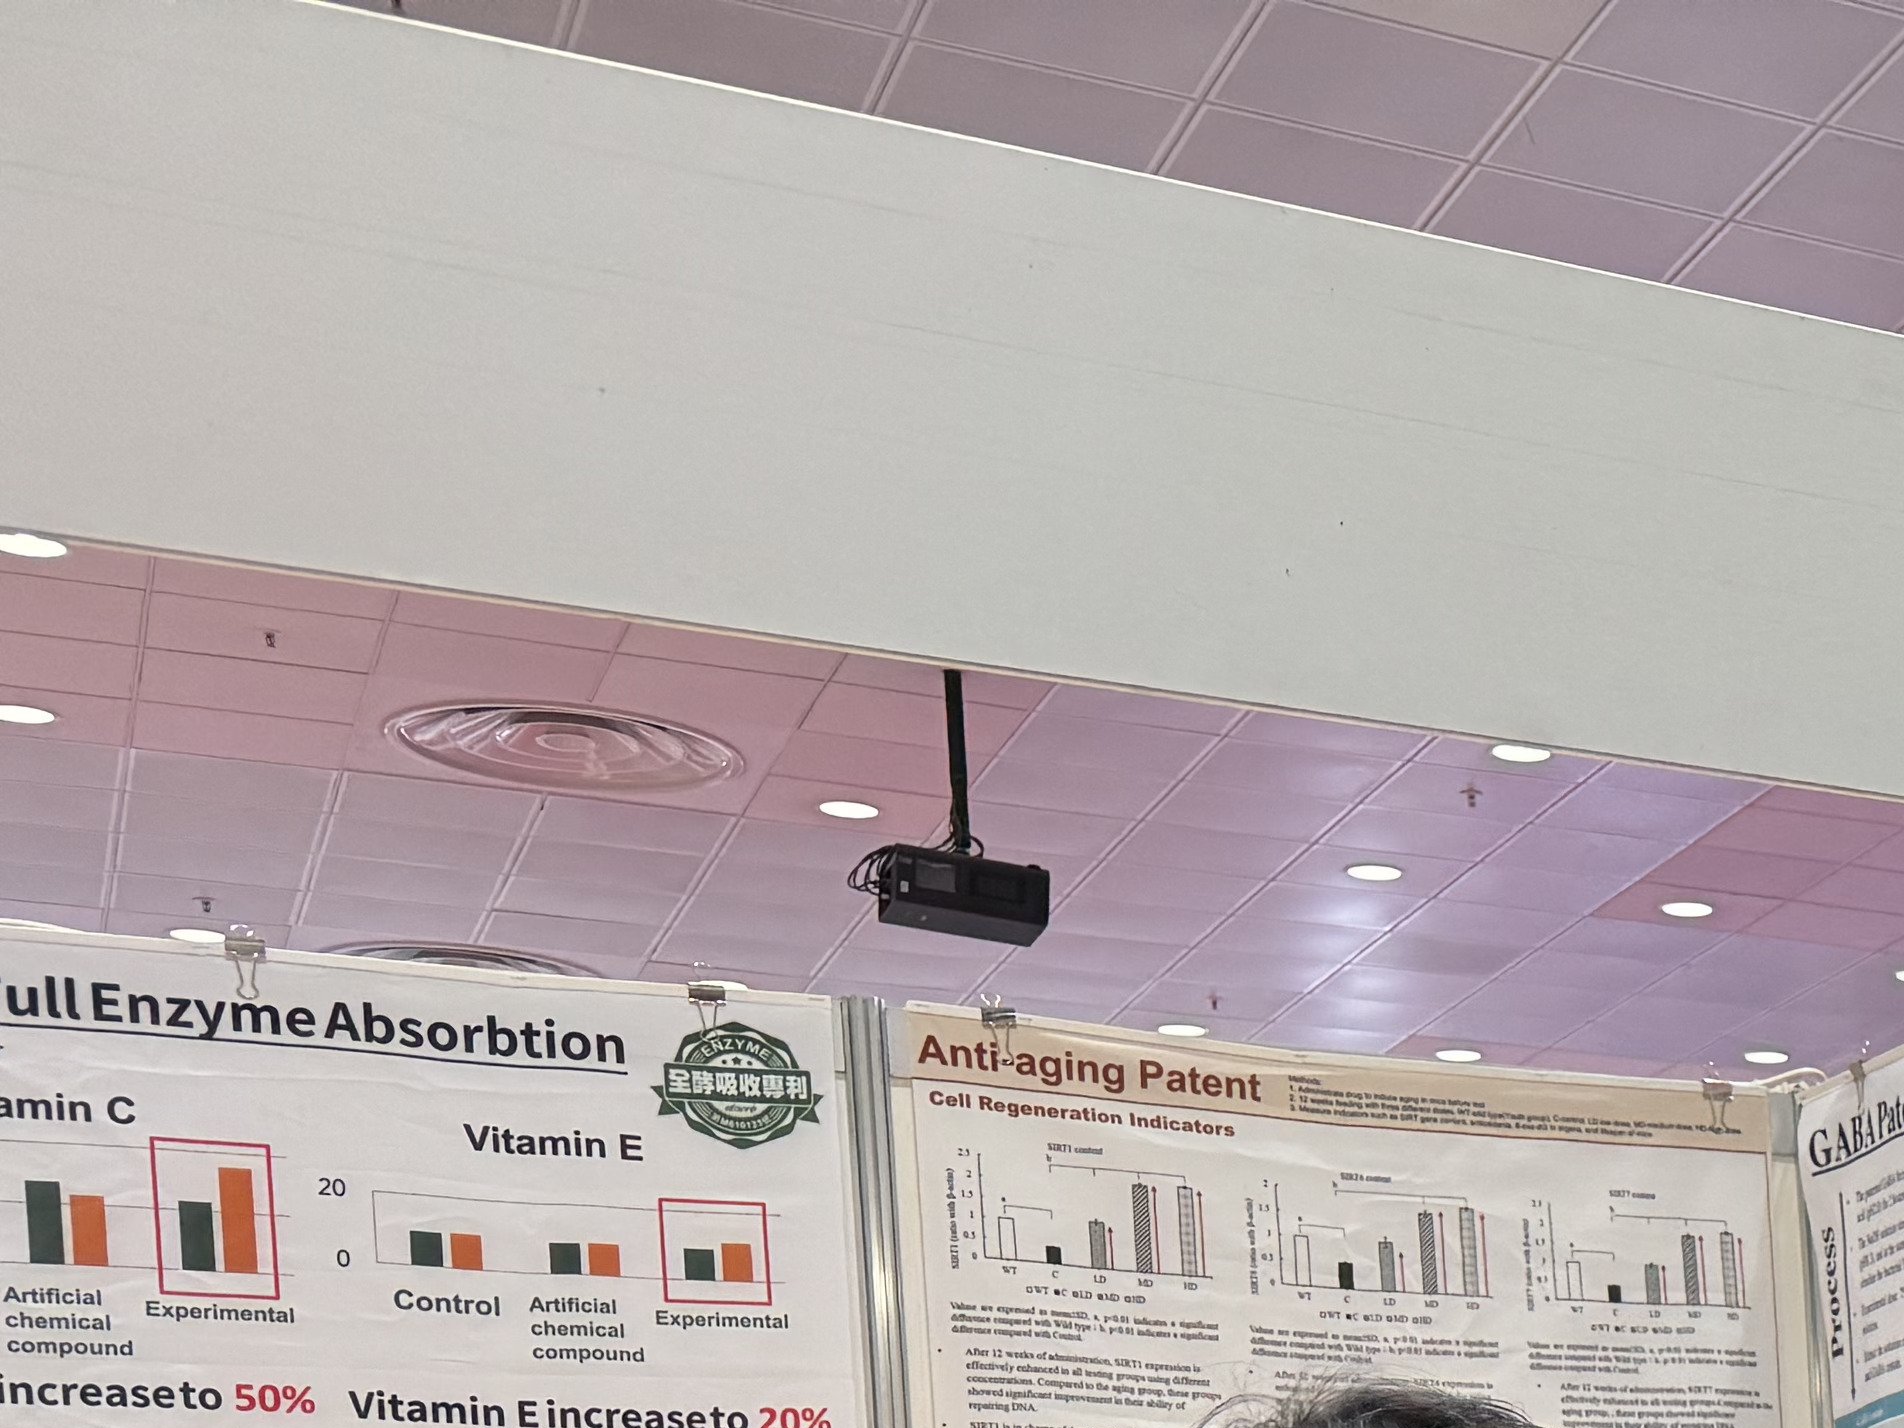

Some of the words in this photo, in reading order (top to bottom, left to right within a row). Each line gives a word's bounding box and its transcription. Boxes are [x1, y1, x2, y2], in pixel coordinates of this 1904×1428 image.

[0, 974, 82, 1021] ull
[93, 982, 315, 1041] Enzyme
[325, 1003, 626, 1065] Absorbtion
[701, 1039, 771, 1059] ENZYME
[918, 1034, 1126, 1094] Anti-aging
[1139, 1060, 1262, 1102] Patent
[668, 1069, 807, 1099] 全酵吸收專利
[107, 1096, 136, 1124] C
[929, 1090, 972, 1112] Cell
[979, 1095, 1124, 1129] Regeneration
[1129, 1112, 1235, 1137] Indicators
[463, 1124, 606, 1158] Vitamin
[620, 1134, 643, 1161] E
[1809, 1110, 1875, 1170] GABA
[318, 1177, 346, 1197] 20
[337, 1249, 350, 1267] 0
[3, 1286, 102, 1306] Artificial
[394, 1289, 500, 1316] Control
[529, 1297, 616, 1314] Artificial
[5, 1312, 111, 1331] chemical
[145, 1301, 294, 1324] Experimental
[656, 1310, 788, 1330] Experimental
[531, 1320, 624, 1338] chemical
[7, 1340, 133, 1358] compound
[533, 1347, 645, 1363] compound
[234, 1384, 315, 1415] 50%
[350, 1391, 506, 1427] Vitamin
